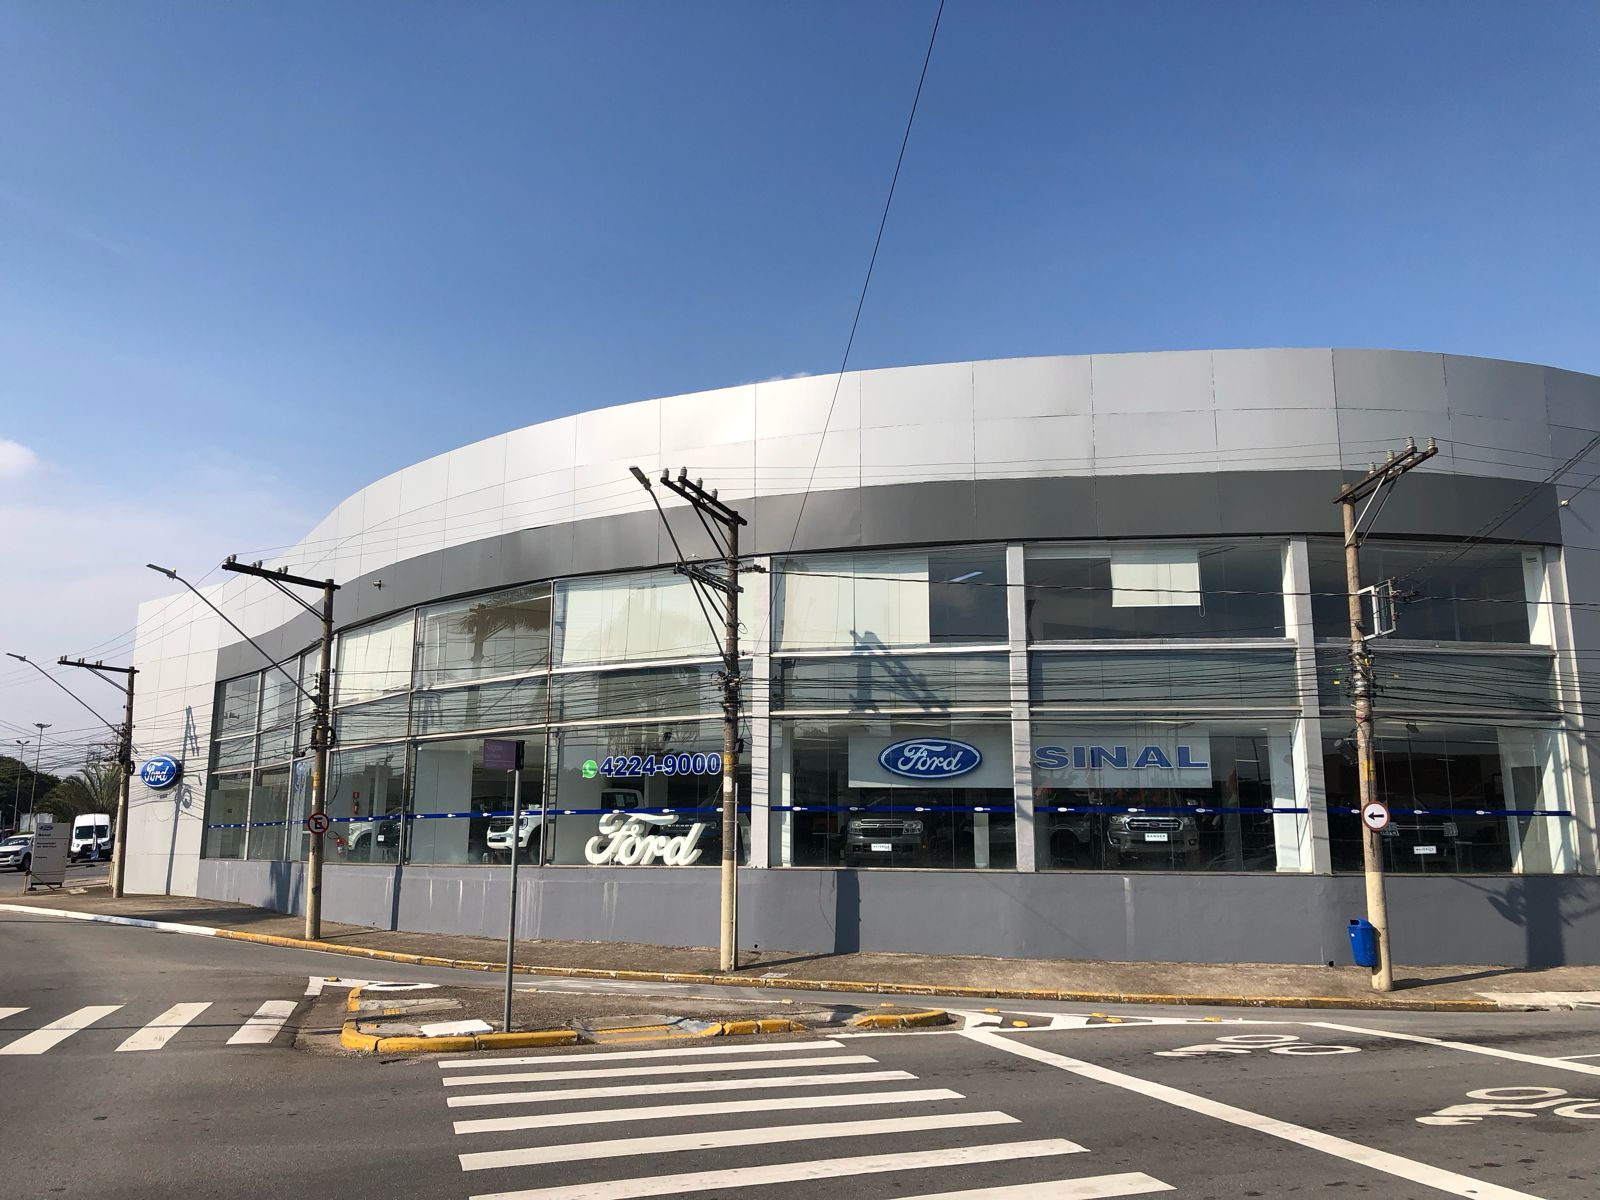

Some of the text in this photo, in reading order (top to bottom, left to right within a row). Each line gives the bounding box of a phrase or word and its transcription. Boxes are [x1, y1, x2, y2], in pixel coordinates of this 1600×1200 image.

[600, 753, 721, 777] 4224-9000
[898, 744, 963, 771] Ford
[1034, 745, 1209, 769] SINAL
[144, 761, 170, 782] Ford
[585, 813, 705, 866] Ford
